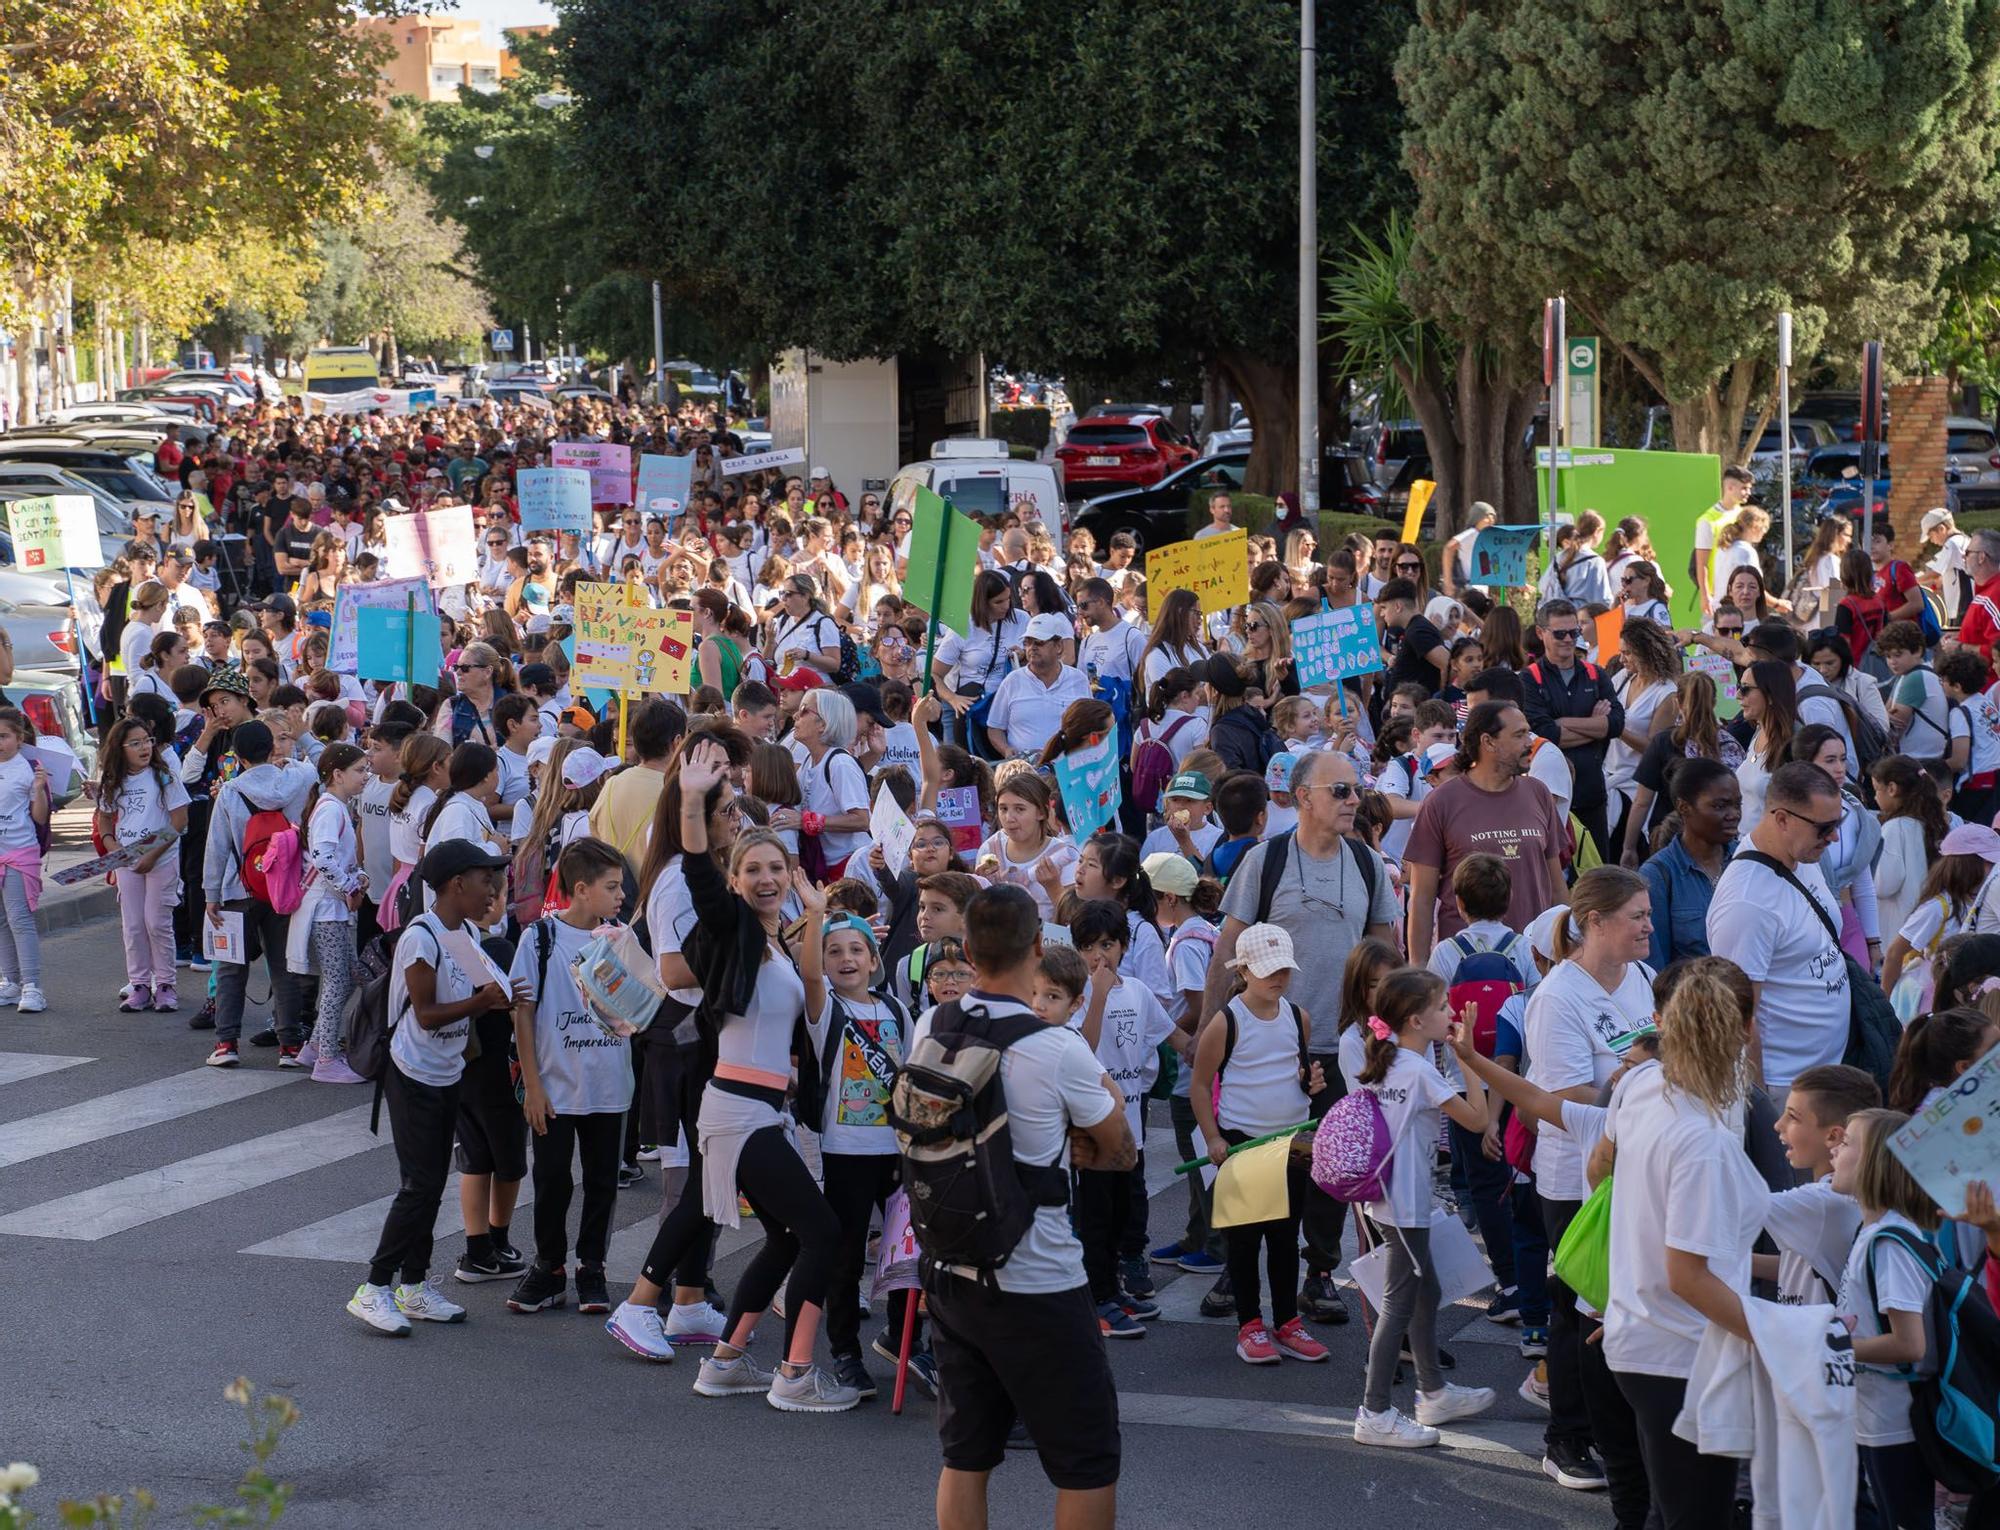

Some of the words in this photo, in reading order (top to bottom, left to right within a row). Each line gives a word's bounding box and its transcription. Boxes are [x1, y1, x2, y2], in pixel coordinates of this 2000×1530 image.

[578, 583, 624, 596] VIVA
[363, 802, 391, 816] NASA
[1471, 829, 1517, 843] NOTTING
[1521, 828, 1542, 837] HILL
